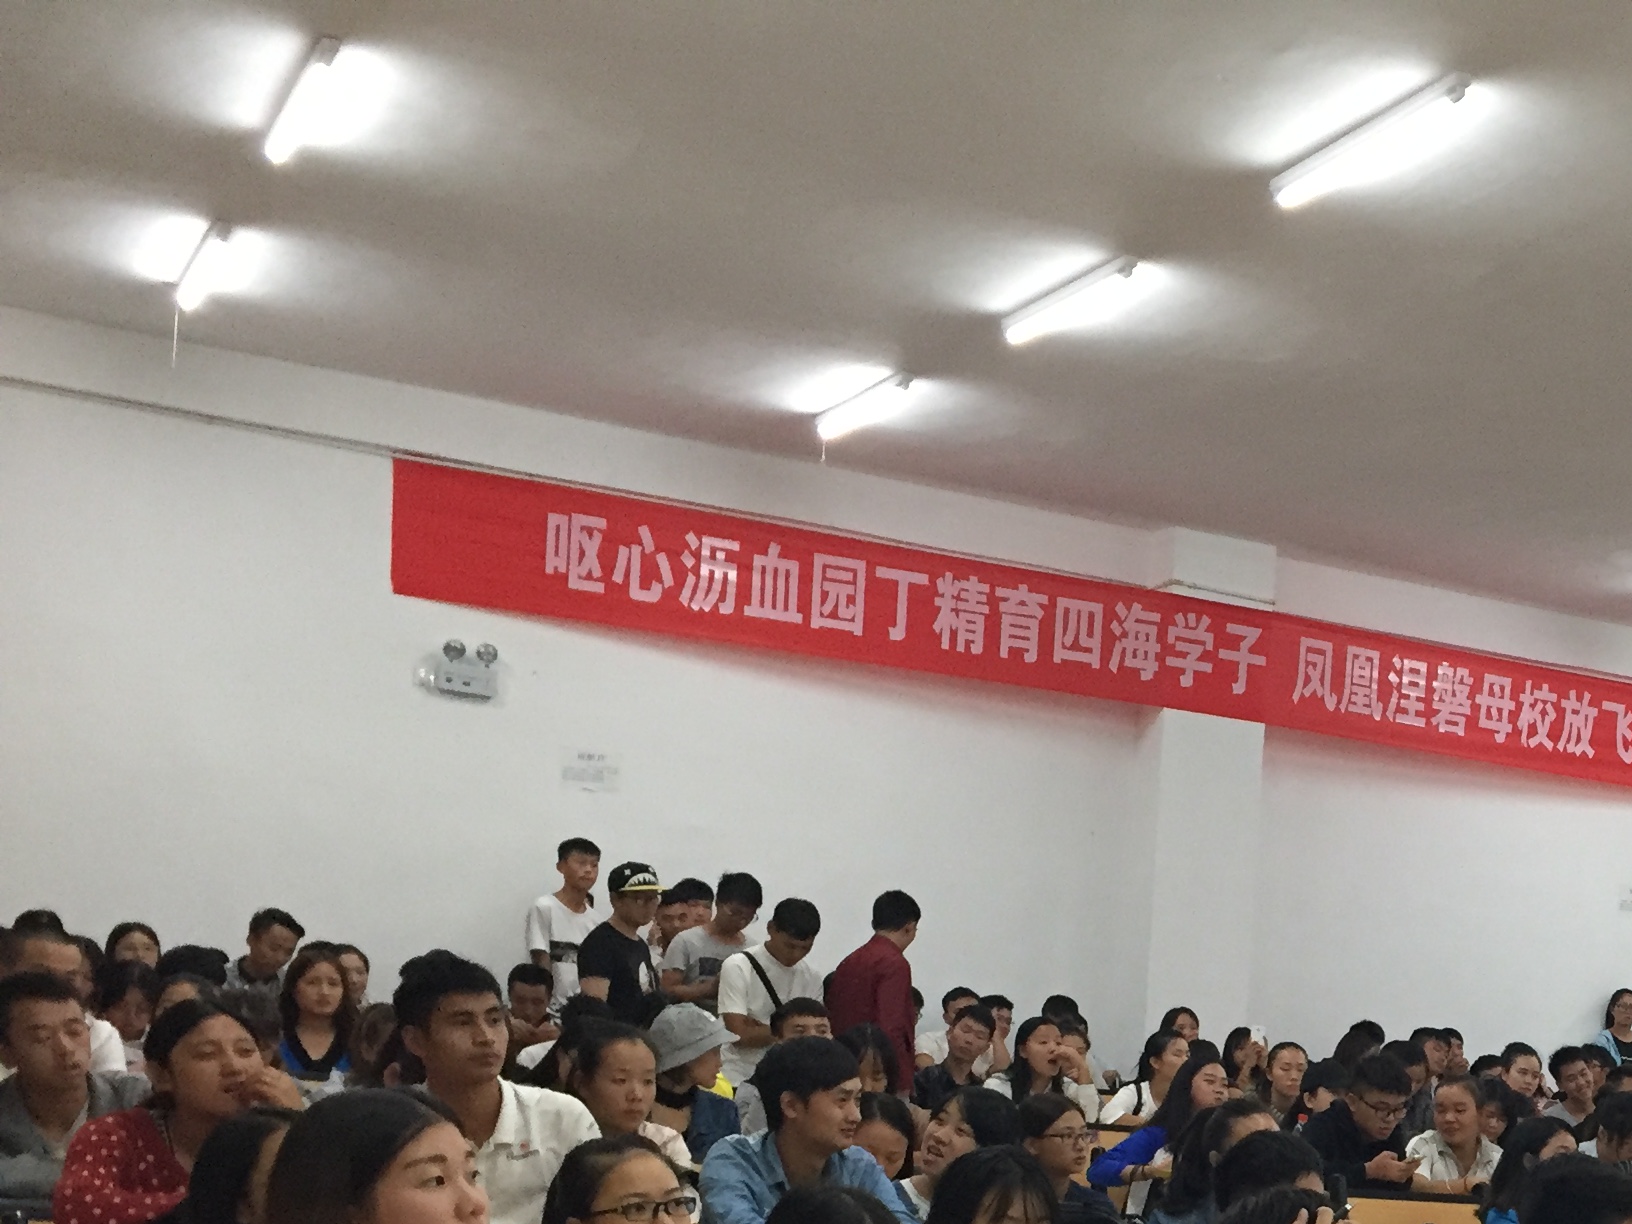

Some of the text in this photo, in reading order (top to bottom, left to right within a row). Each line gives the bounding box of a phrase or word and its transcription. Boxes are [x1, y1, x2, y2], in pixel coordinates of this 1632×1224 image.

[545, 513, 1267, 695] 呕心沥血园丁精育四海学子
